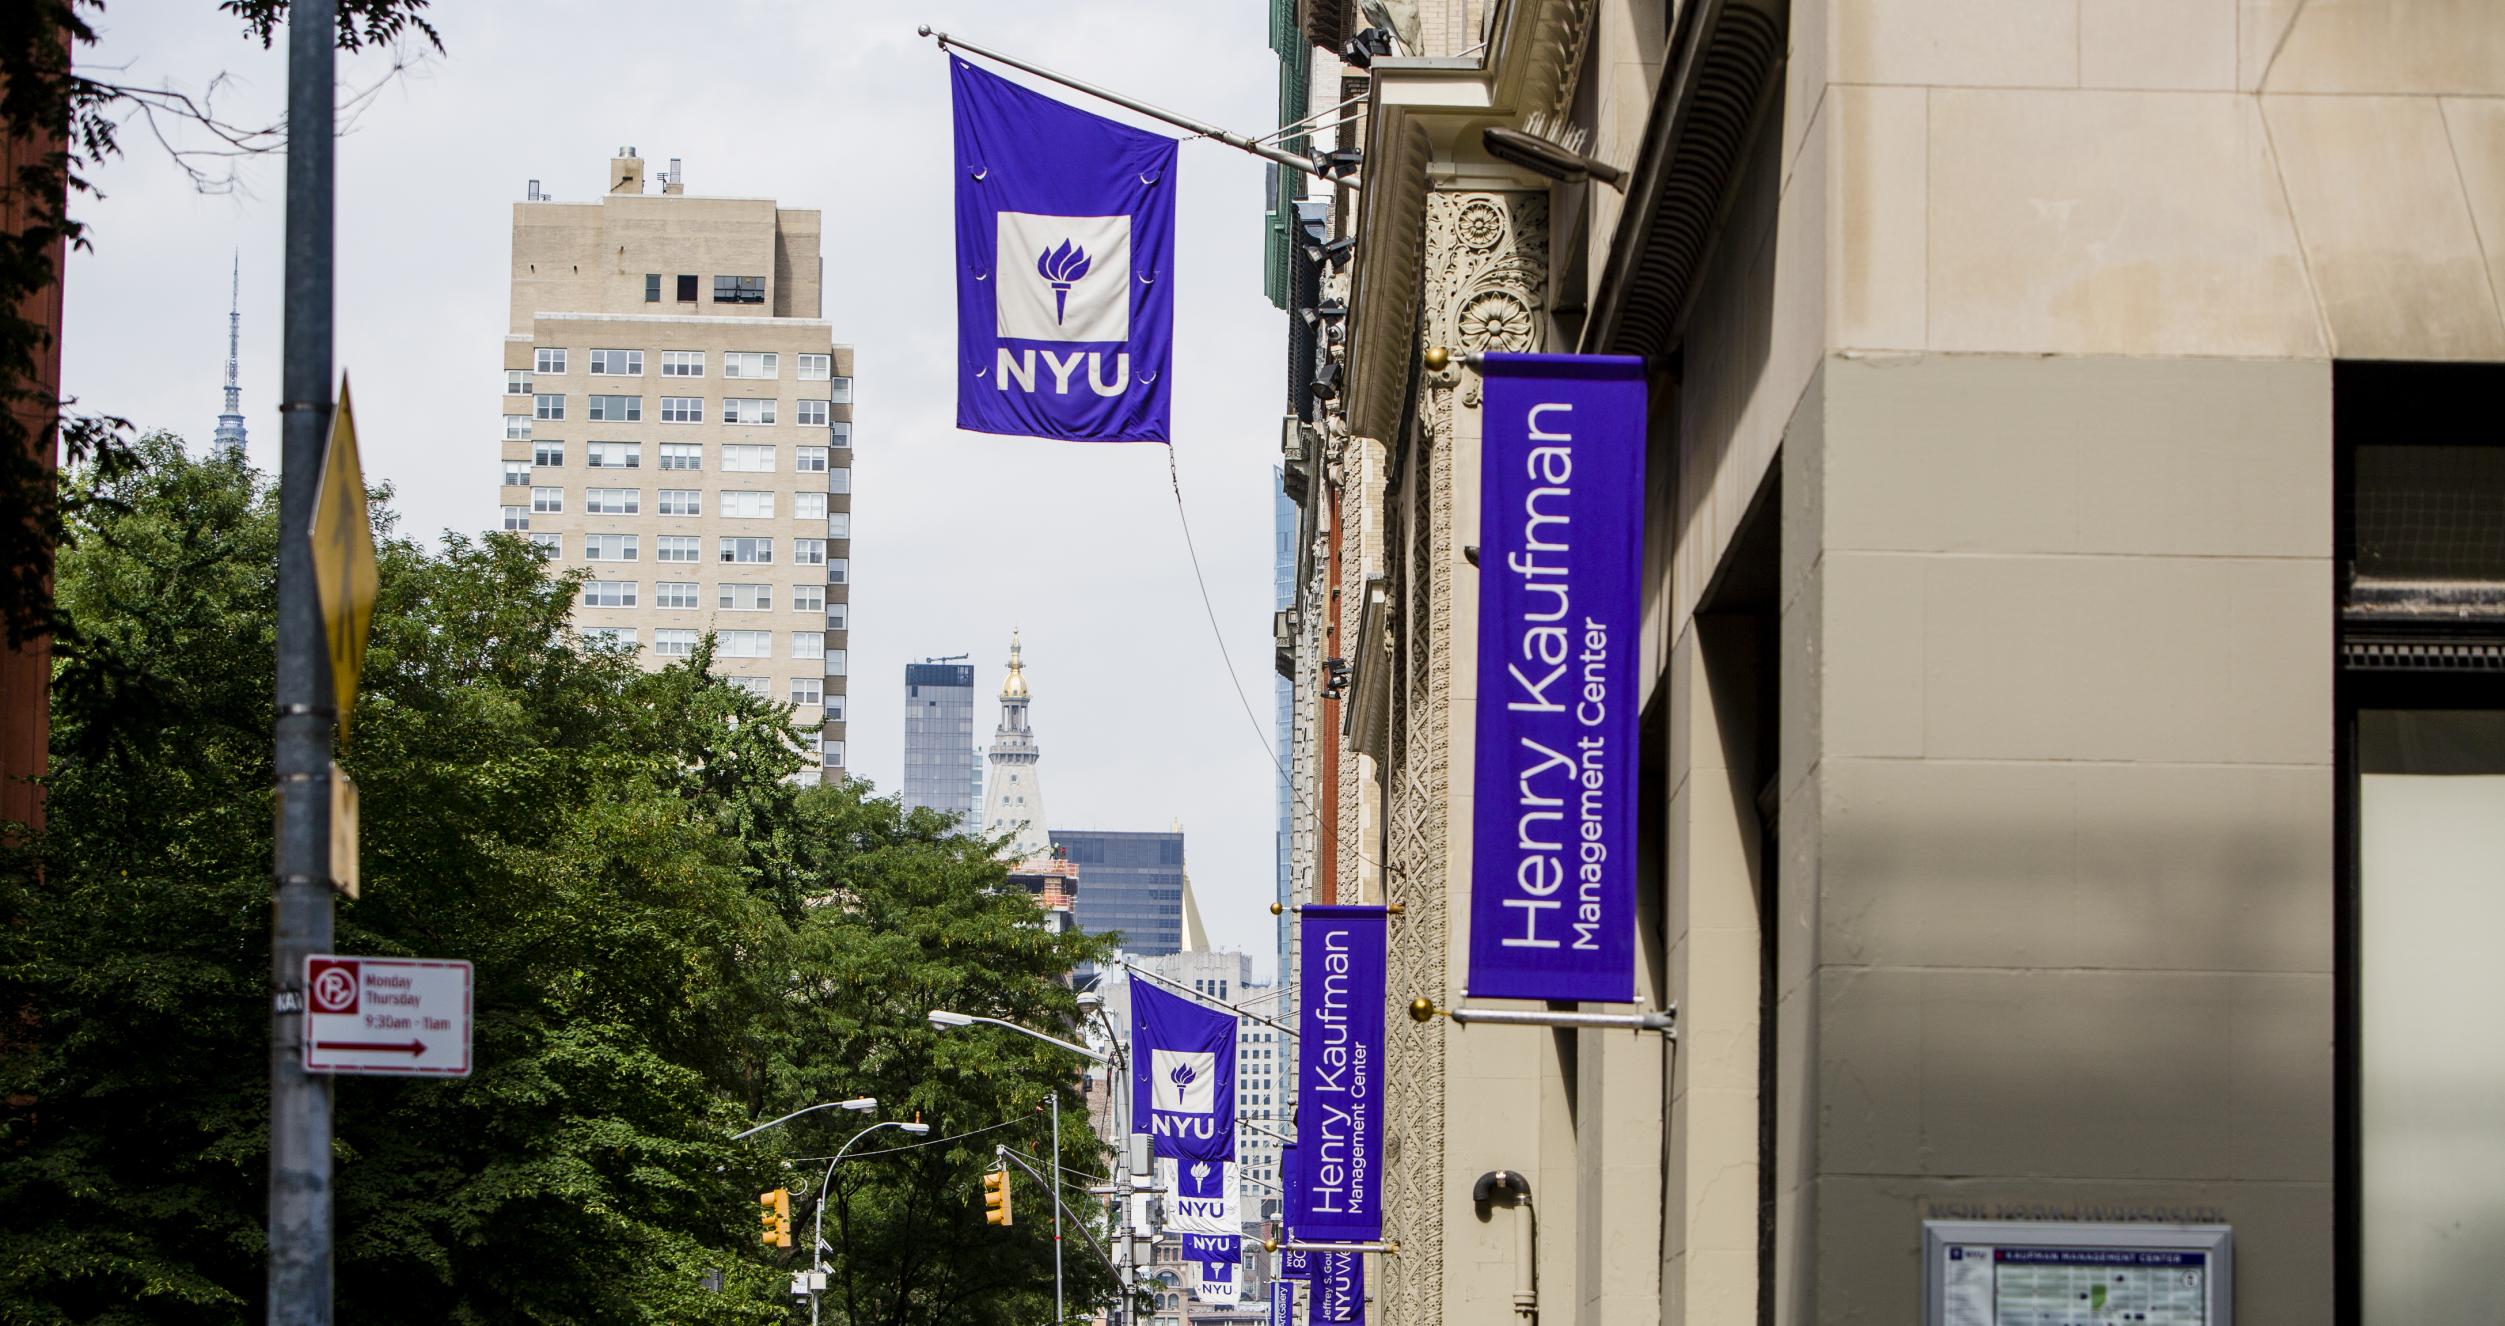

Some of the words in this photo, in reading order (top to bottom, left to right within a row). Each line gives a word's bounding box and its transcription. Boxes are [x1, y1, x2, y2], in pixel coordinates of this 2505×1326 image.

[997, 348, 1130, 397] NYU
[1507, 403, 1573, 712] Kaufman
[1576, 616, 1608, 726] Center
[1501, 737, 1578, 948] Henry
[1572, 736, 1607, 950] Management
[365, 974, 413, 990] Monday
[366, 990, 421, 1008] Thursday
[365, 1014, 412, 1030] 9:30am
[423, 1016, 451, 1031] 11am
[1315, 930, 1349, 1092] Kaufman
[1350, 1041, 1367, 1099] Center
[1152, 1113, 1214, 1139] NYU
[1312, 1104, 1351, 1213] Henry
[1348, 1103, 1367, 1213] Management
[1178, 1200, 1224, 1218] NYU
[1193, 1236, 1230, 1251] NYU
[1323, 1251, 1333, 1274] Goul
[1202, 1283, 1233, 1295] NYU
[1323, 1287, 1334, 1321] Jeffrey
